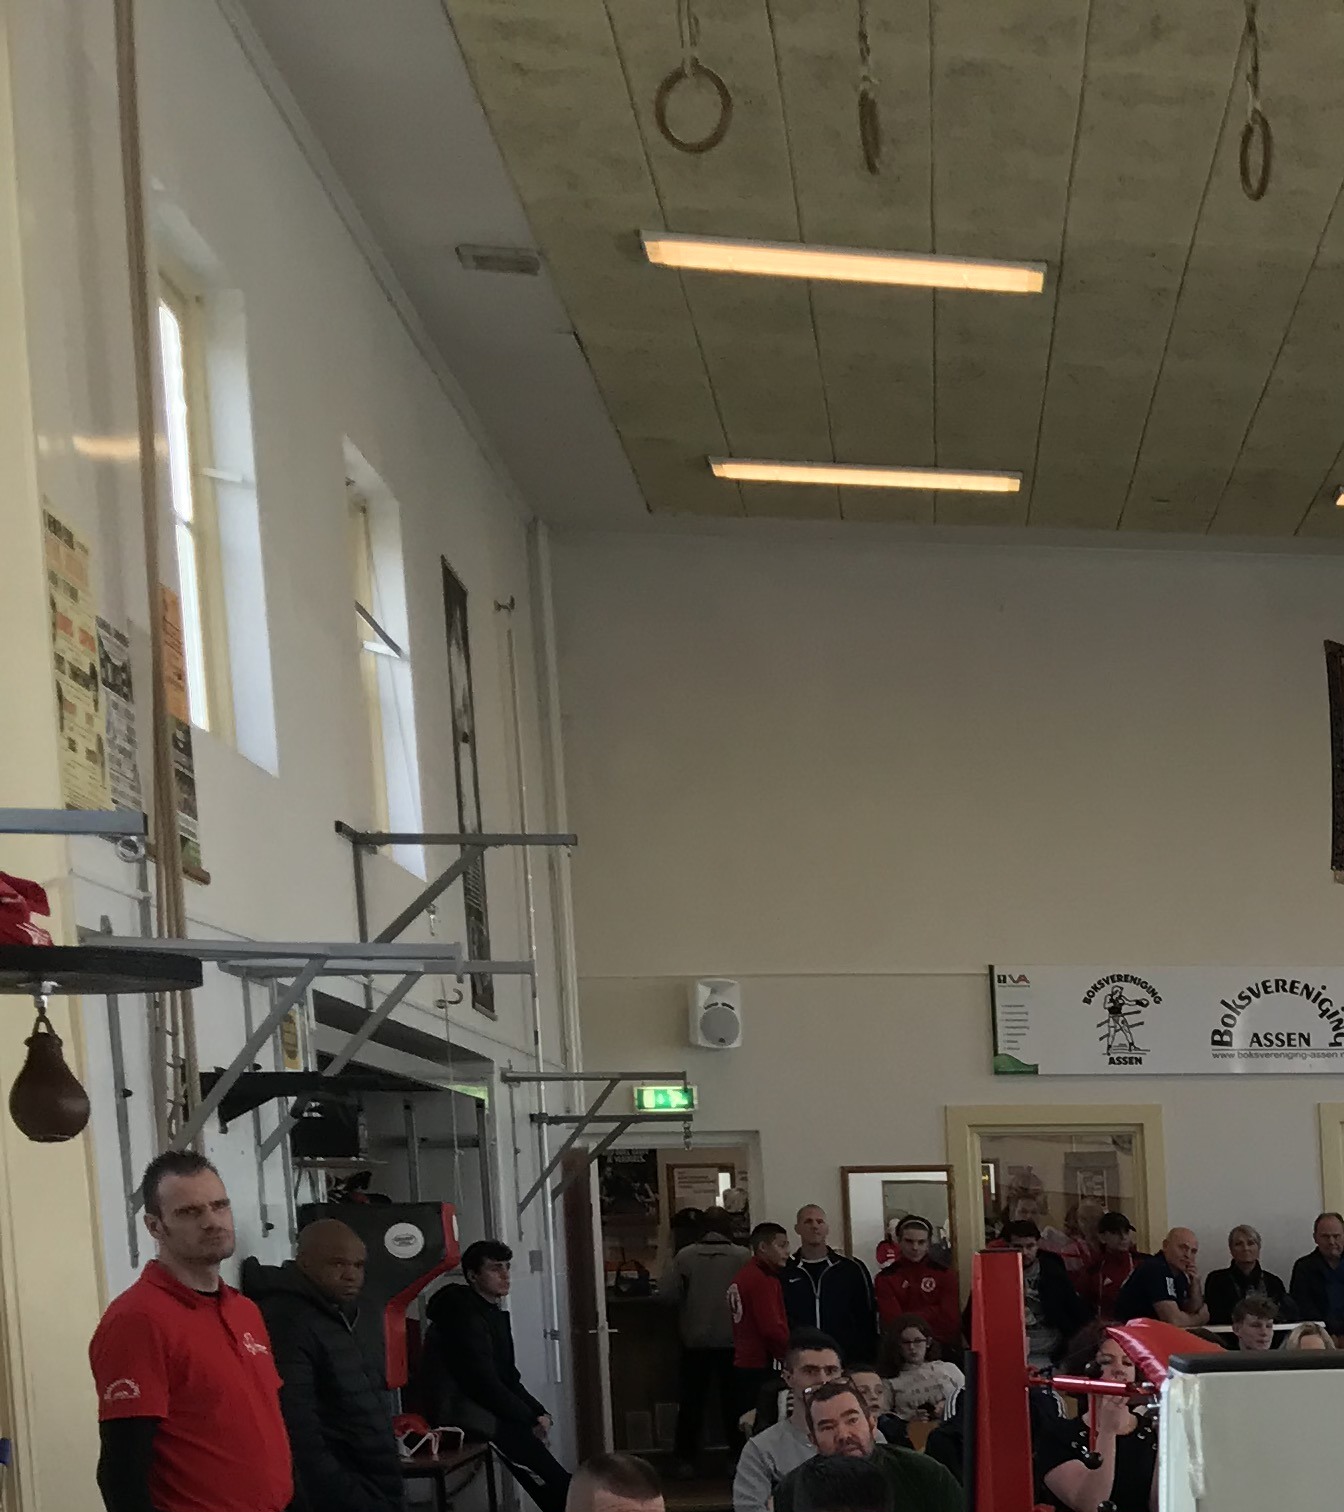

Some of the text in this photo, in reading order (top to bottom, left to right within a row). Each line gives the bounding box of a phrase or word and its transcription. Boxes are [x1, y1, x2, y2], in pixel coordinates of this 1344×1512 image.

[1082, 973, 1162, 1005] BOKSVERENIGING
[1249, 1031, 1311, 1048] ASSEN
[1108, 1056, 1142, 1066] ASSEN
